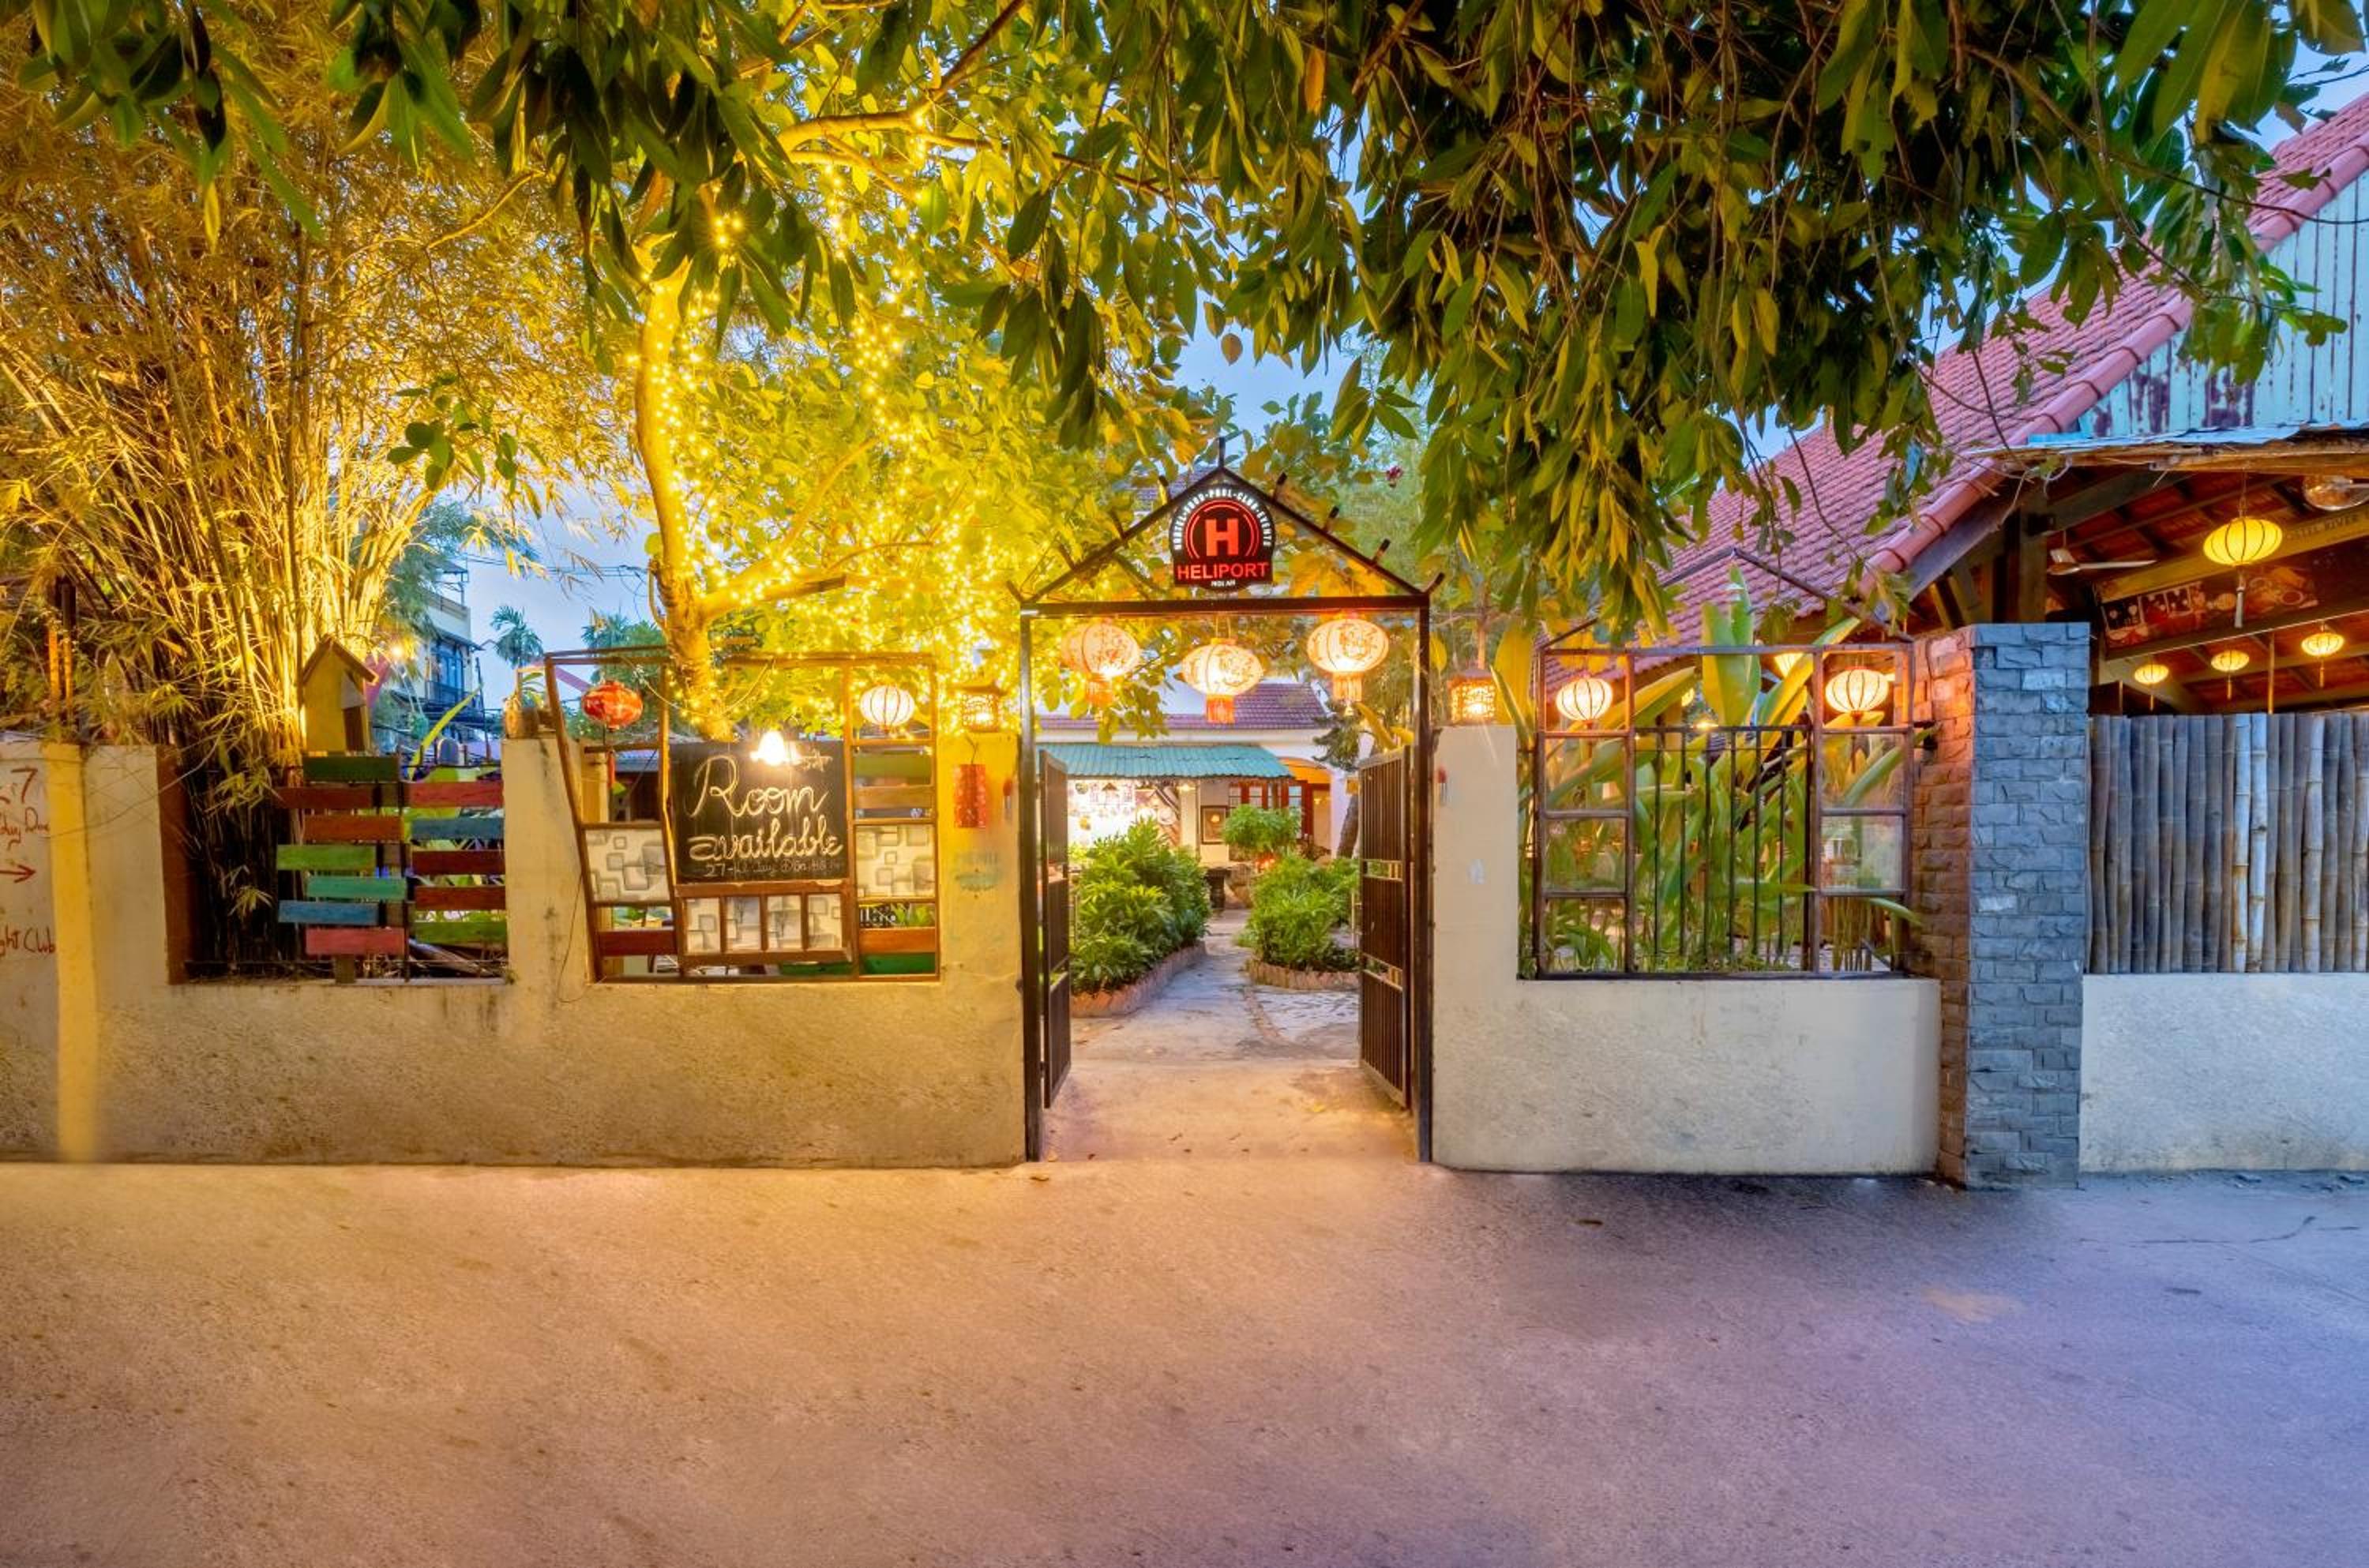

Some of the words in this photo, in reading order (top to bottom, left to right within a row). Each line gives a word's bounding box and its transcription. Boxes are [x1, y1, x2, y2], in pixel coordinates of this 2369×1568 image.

[1205, 518, 1239, 557] H
[1177, 562, 1269, 580] HELIPORT
[686, 754, 828, 818] Room
[687, 814, 843, 861] available
